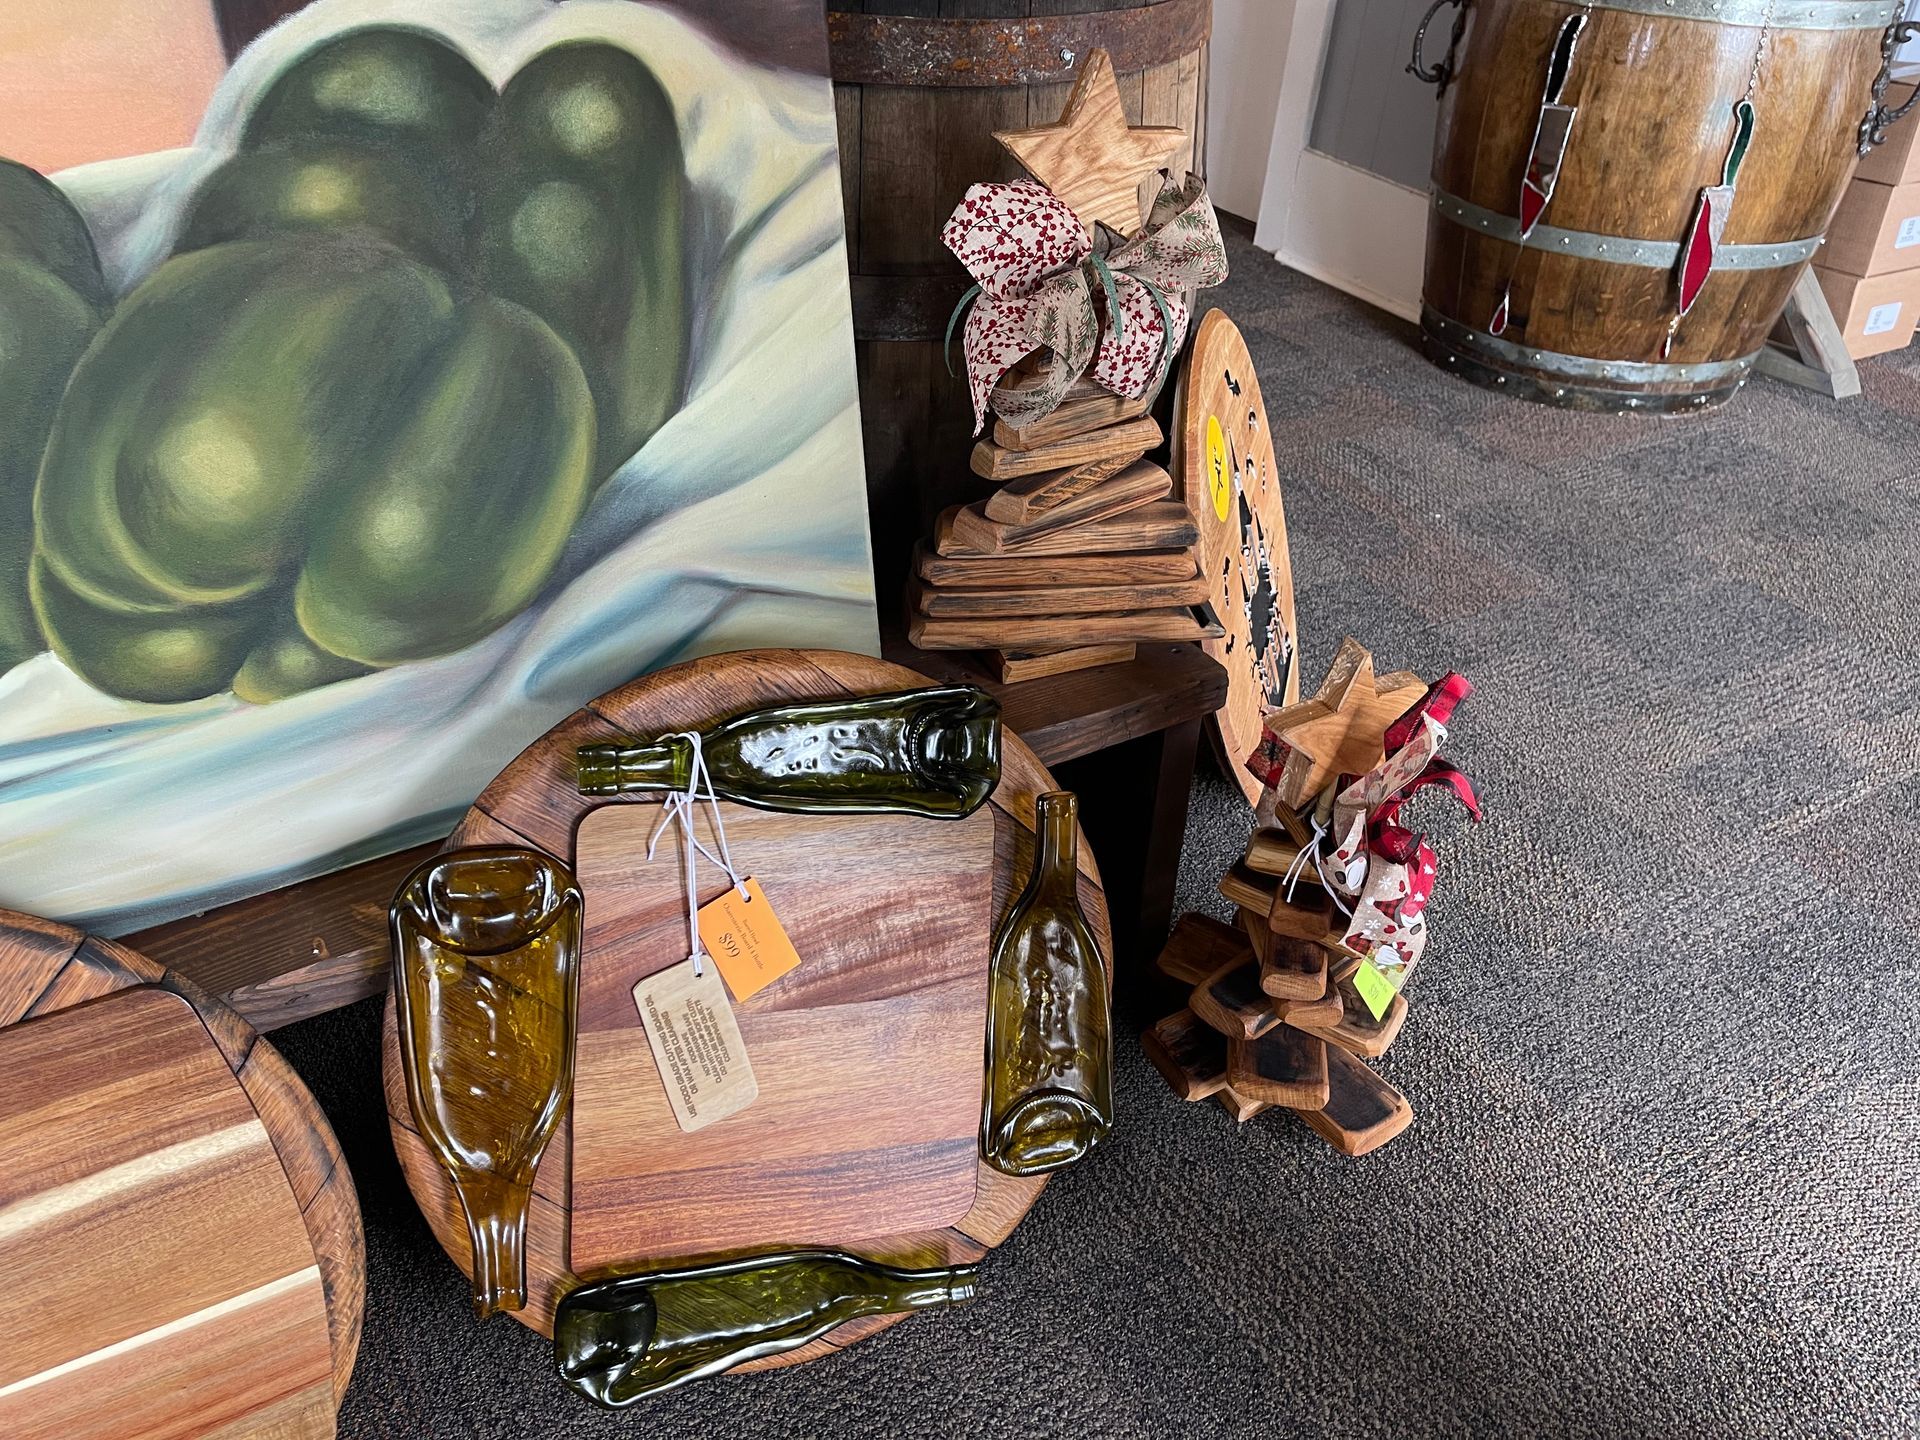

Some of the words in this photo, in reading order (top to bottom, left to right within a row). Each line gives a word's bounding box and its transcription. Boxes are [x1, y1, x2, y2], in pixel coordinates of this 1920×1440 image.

[718, 932, 741, 958] $99
[739, 932, 753, 949] Board
[643, 994, 654, 1007] OIL
[684, 997, 697, 1018] CLOTH
[648, 1006, 664, 1032] BOARD
[681, 1012, 692, 1026] SAFE
[693, 999, 708, 1024] OBJECTS
[704, 1005, 716, 1022] ONLY
[660, 1010, 679, 1046] CLEANING
[692, 1017, 702, 1032] SOFT
[710, 1021, 725, 1046] SERVING
[658, 1031, 675, 1062] CUTTING
[681, 1031, 691, 1046] SAFE
[687, 1025, 706, 1063] DISHWASHER
[698, 1031, 709, 1049] DAMP
[710, 1041, 719, 1053] USE
[674, 1044, 688, 1067] AFTER
[686, 1045, 698, 1063] FOOD
[704, 1048, 715, 1065] WITH
[714, 1053, 724, 1066] NOT
[719, 1045, 731, 1062] COLD
[669, 1060, 685, 1085] GRADE
[682, 1065, 694, 1084] WAX
[701, 1063, 711, 1076] NOT
[710, 1064, 722, 1083] CLEAN
[719, 1065, 728, 1075] DO
[679, 1084, 692, 1104] FOOD
[689, 1083, 698, 1094] OR
[686, 1103, 698, 1118] USE
